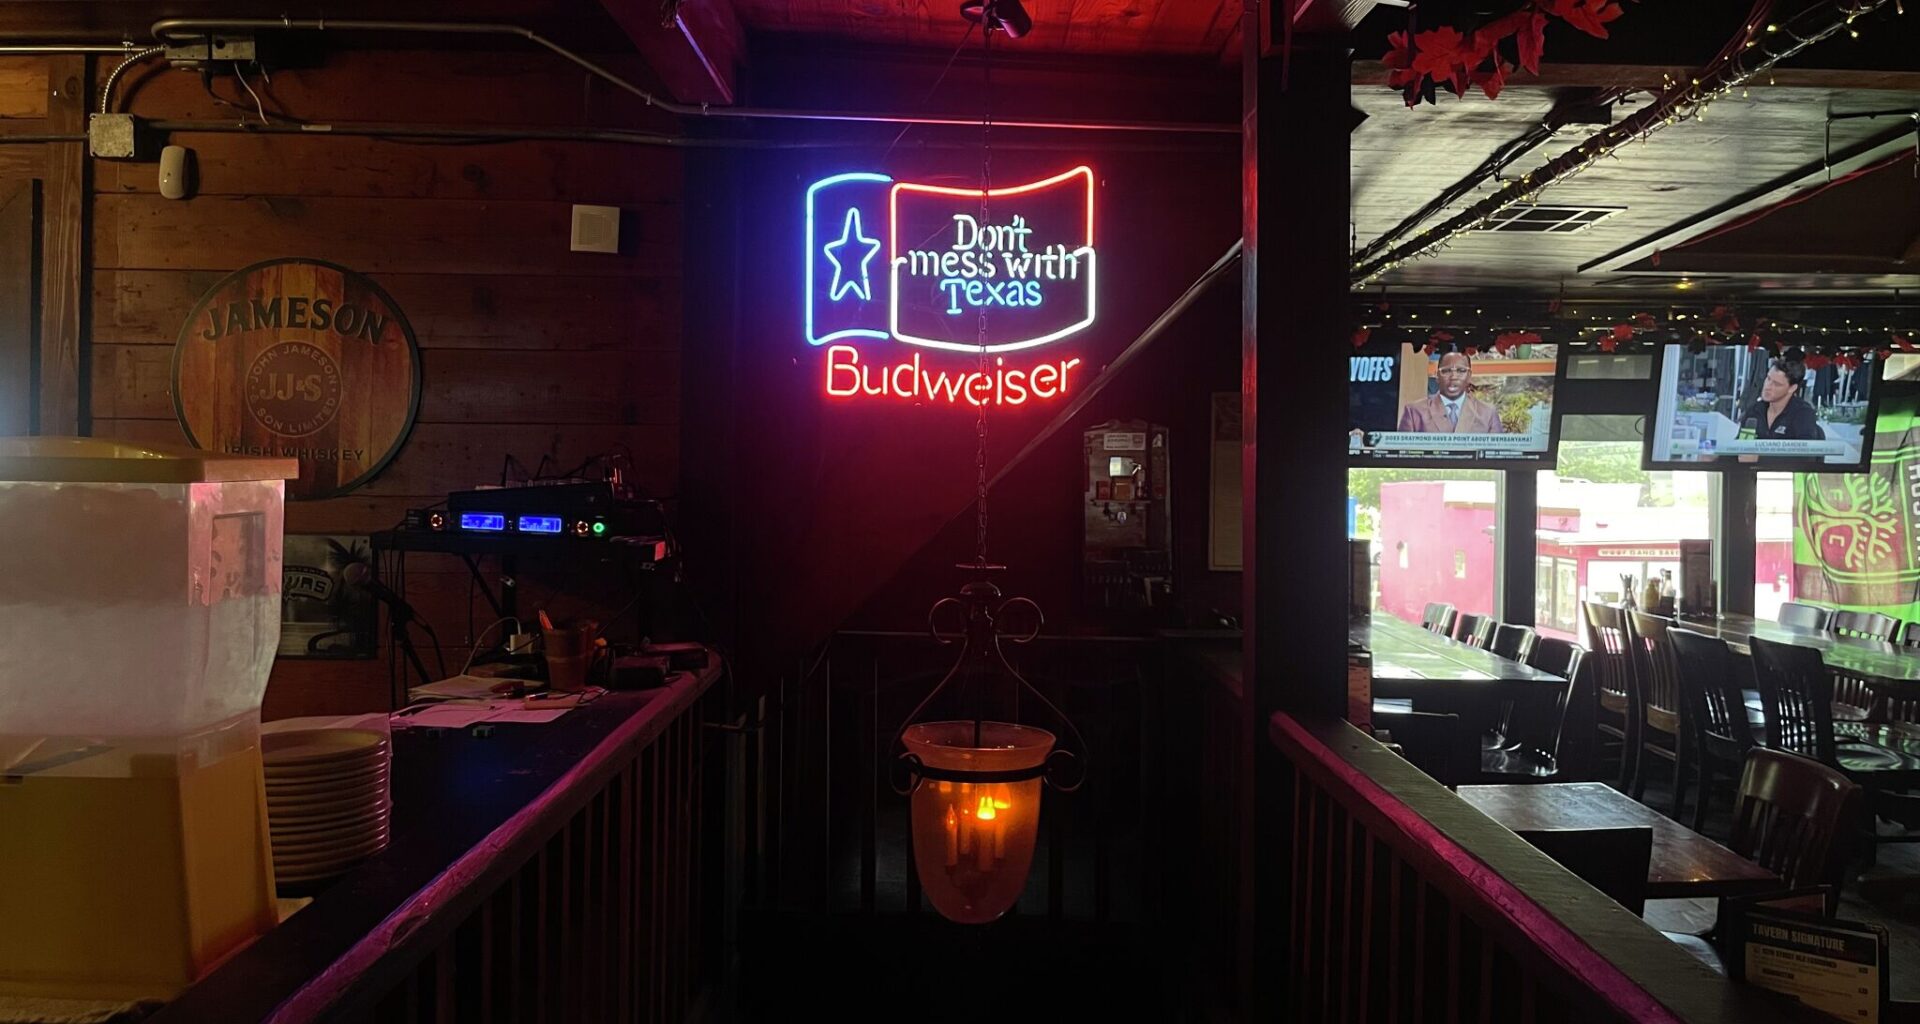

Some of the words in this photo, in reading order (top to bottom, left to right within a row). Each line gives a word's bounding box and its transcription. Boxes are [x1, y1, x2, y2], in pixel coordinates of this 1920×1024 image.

[952, 213, 1032, 252] Don't
[908, 249, 997, 279] mess
[1001, 243, 1078, 280] with
[940, 278, 1043, 314] Texas
[202, 296, 390, 346] JAMESON
[249, 350, 278, 383] JOHN
[283, 345, 337, 384] JAMESON
[826, 345, 1080, 406] Budweiser
[257, 407, 284, 431] SON
[289, 399, 337, 434] LIMITED
[281, 447, 364, 461] WHISKEY
[1752, 923, 1789, 942] TAVERN
[1791, 931, 1846, 951] SIGNATURE
